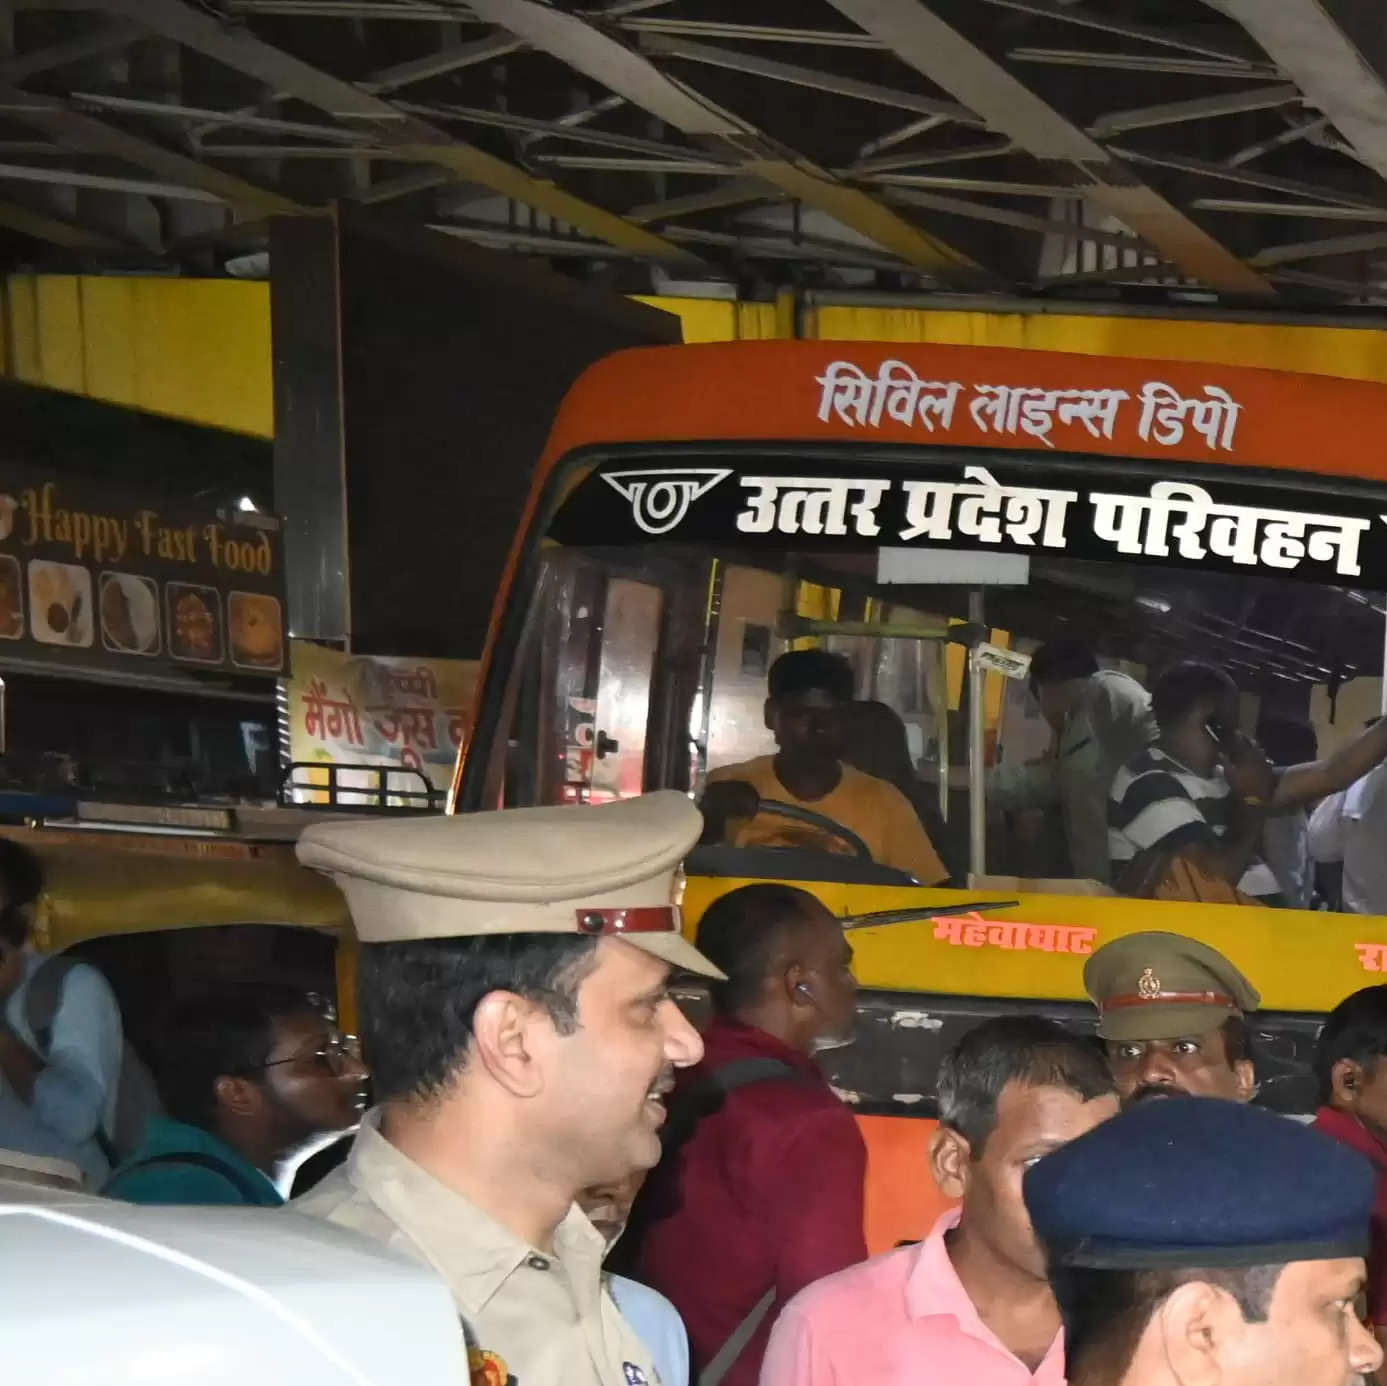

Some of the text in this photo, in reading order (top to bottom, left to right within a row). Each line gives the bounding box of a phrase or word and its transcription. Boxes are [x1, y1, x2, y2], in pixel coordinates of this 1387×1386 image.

[815, 360, 1244, 452] सिविल लाइन्स डिपो
[21, 482, 272, 576] Happy Fast Food
[735, 466, 1370, 577] उत्तर प्रदेश परिवहन
[931, 912, 1099, 955] महेवाघाट
